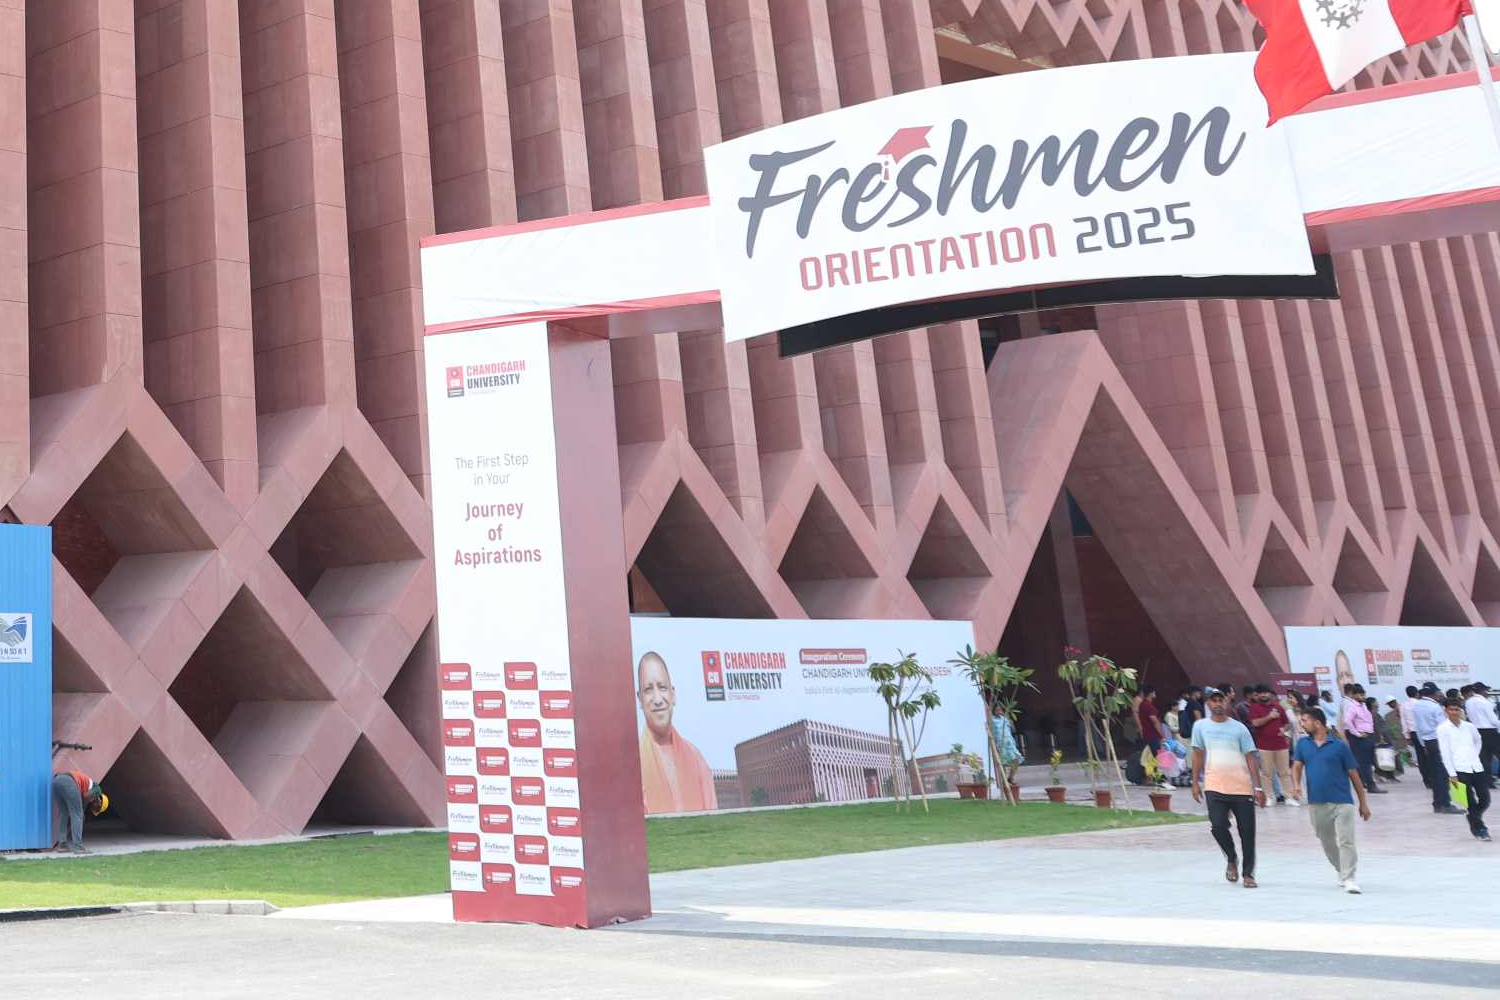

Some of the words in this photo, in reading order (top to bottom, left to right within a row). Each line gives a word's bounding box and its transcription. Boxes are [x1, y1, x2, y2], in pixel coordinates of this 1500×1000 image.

[738, 106, 1246, 259] Freshmen
[799, 222, 1057, 292] ORIENTATION
[1073, 202, 1196, 254] 2025
[466, 360, 526, 377] CHANDIGARH
[467, 373, 520, 390] UNIVERSITY
[455, 457, 474, 470] The
[477, 455, 501, 468] First
[503, 453, 529, 468] Step
[474, 473, 484, 486] in
[486, 472, 510, 486] Your
[465, 502, 524, 522] Journey
[488, 523, 503, 541] of
[454, 545, 542, 569] Aspirations
[724, 651, 787, 670] CHANDIGARH
[726, 671, 783, 690] UNIVERSITY
[801, 668, 852, 680] CHANDIGARH
